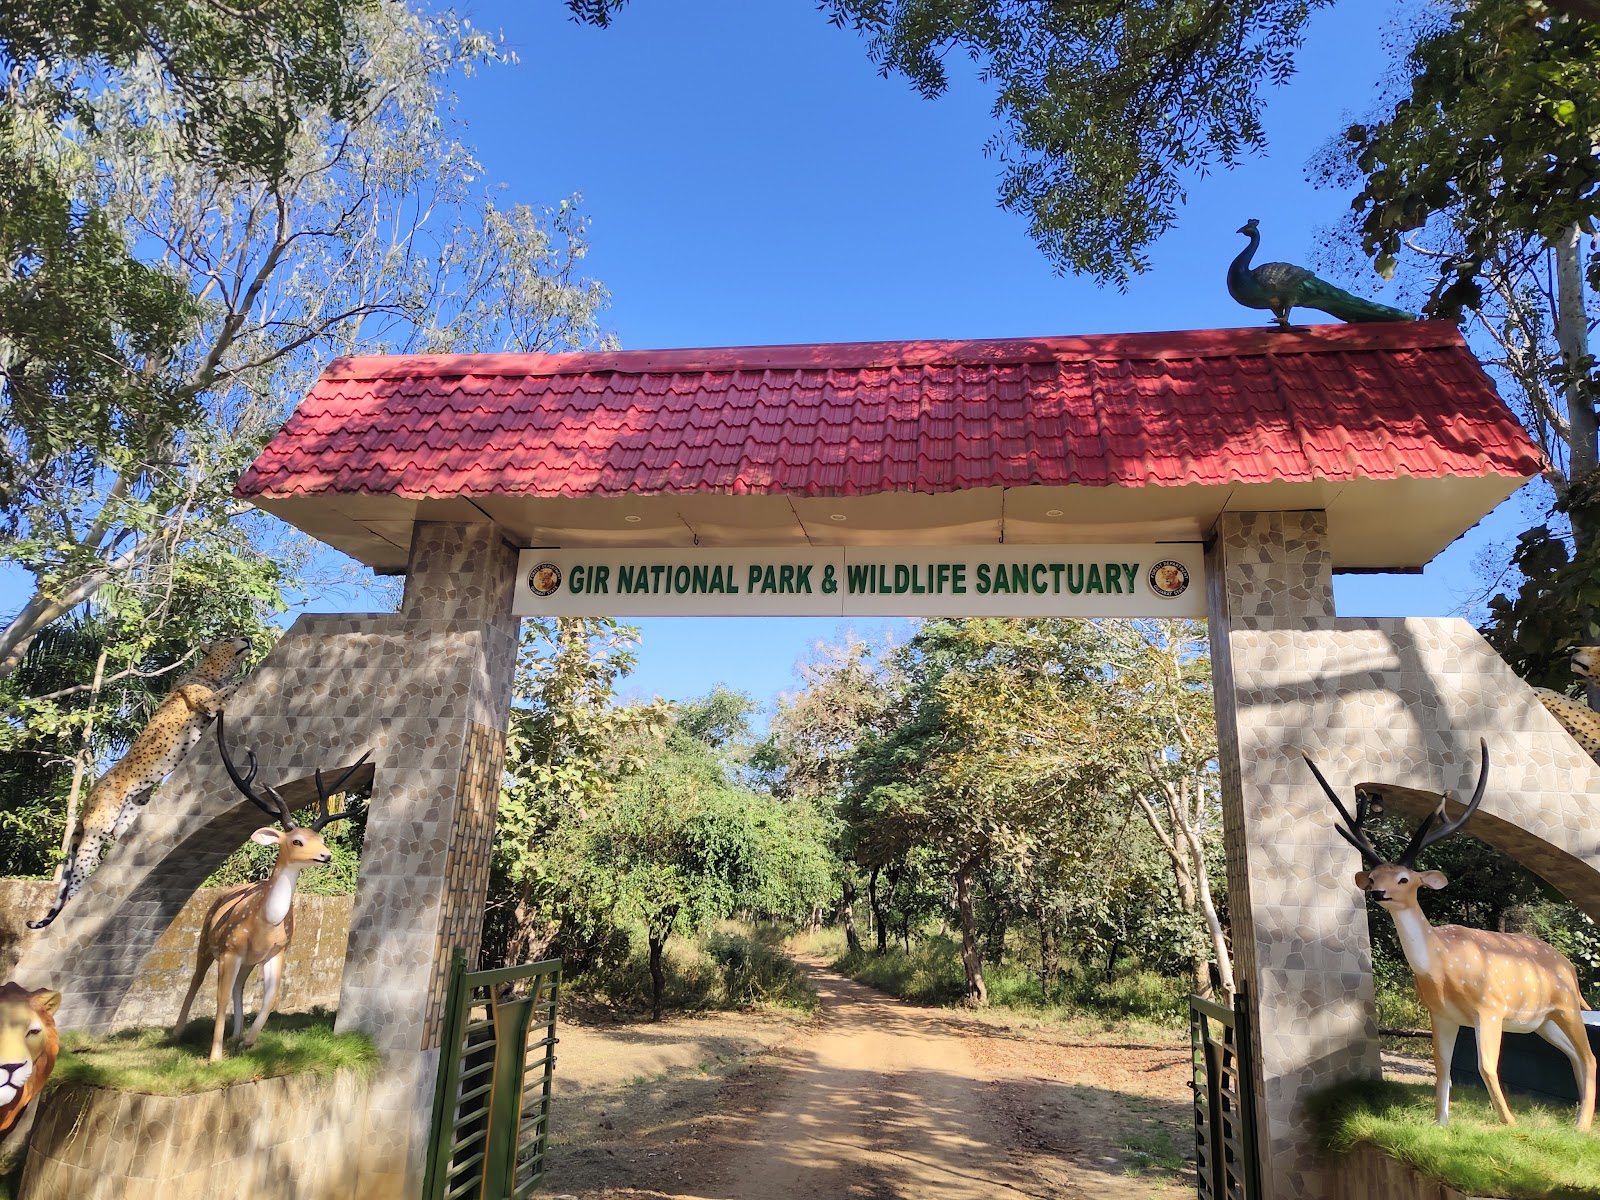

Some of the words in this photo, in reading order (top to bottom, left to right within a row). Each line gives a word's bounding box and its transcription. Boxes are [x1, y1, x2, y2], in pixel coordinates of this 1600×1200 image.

[568, 565, 610, 594] GIR
[617, 565, 739, 594] NATIONAL
[747, 565, 814, 594] PARK
[821, 564, 838, 594] &
[847, 564, 967, 594] WILDLIFE
[976, 563, 1140, 594] SANCTUARY
